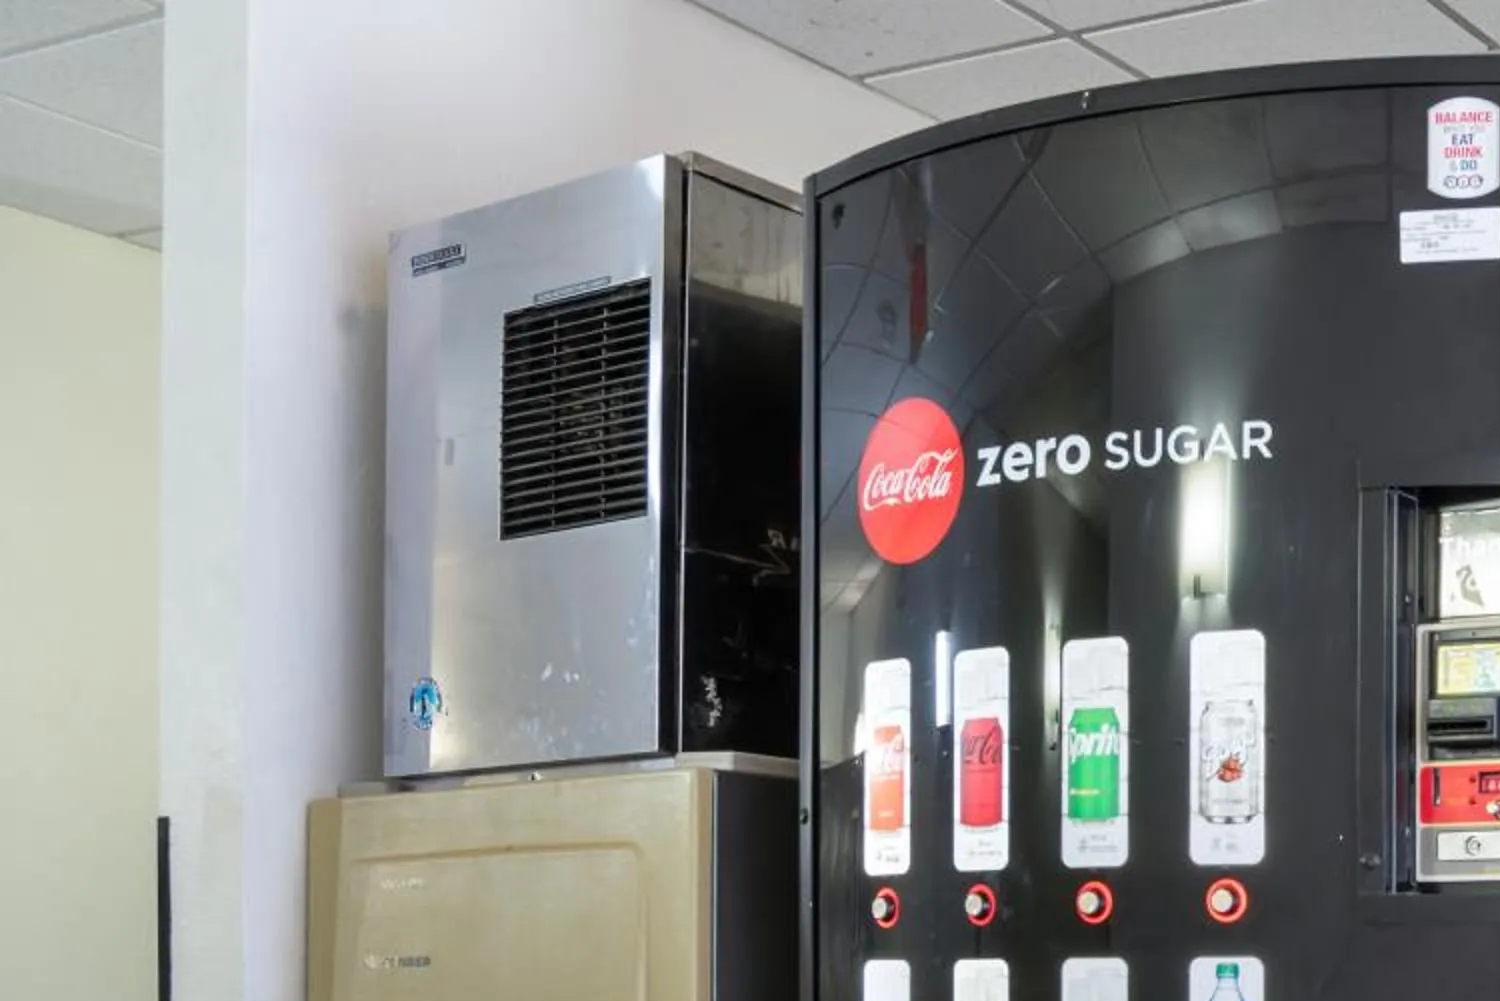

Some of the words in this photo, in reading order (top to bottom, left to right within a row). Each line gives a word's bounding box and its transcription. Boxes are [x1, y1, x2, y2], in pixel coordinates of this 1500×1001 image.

[1435, 111, 1493, 124] BALANCE
[1451, 133, 1474, 145] EAT
[1444, 146, 1483, 159] DRINK
[976, 433, 1092, 487] zero
[1104, 420, 1273, 470] SUGAR
[863, 448, 958, 511] Coca-Cola
